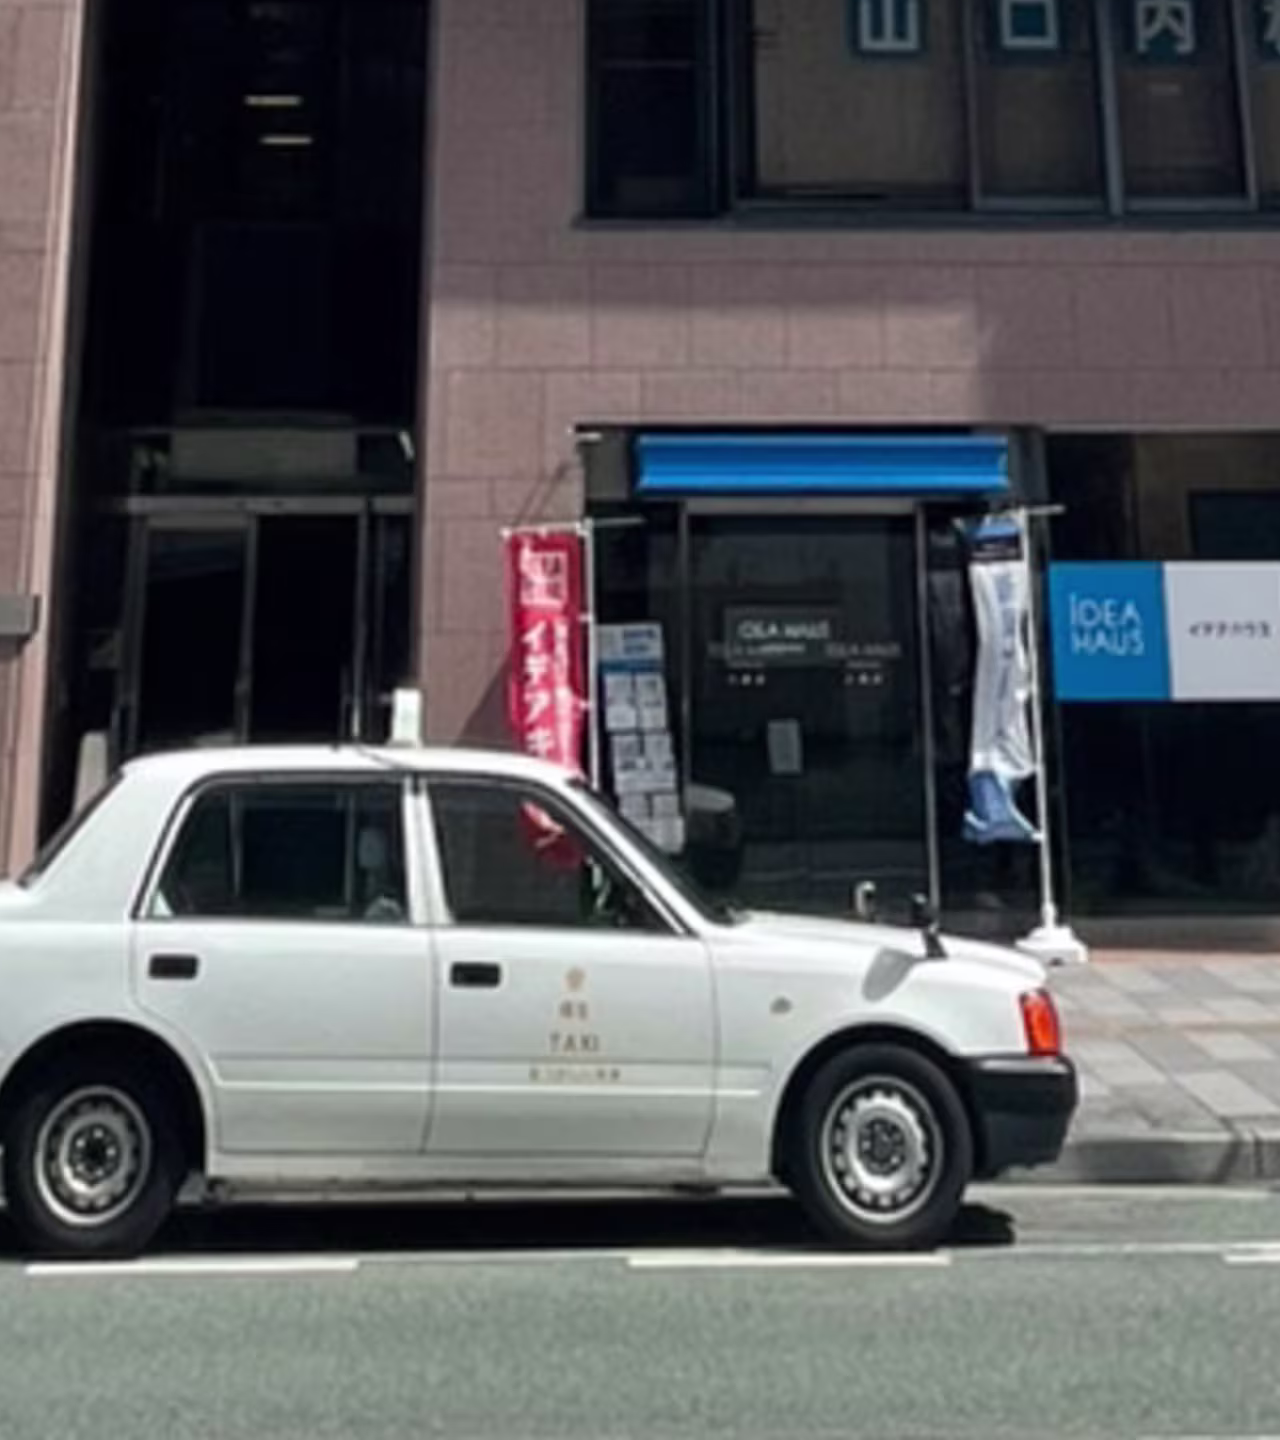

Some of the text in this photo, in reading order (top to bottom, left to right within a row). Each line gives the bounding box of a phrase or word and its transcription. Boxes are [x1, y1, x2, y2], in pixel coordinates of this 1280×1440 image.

[1069, 592, 1143, 627] IDEA
[1071, 629, 1145, 656] HAUS
[549, 1031, 600, 1054] TAXI
